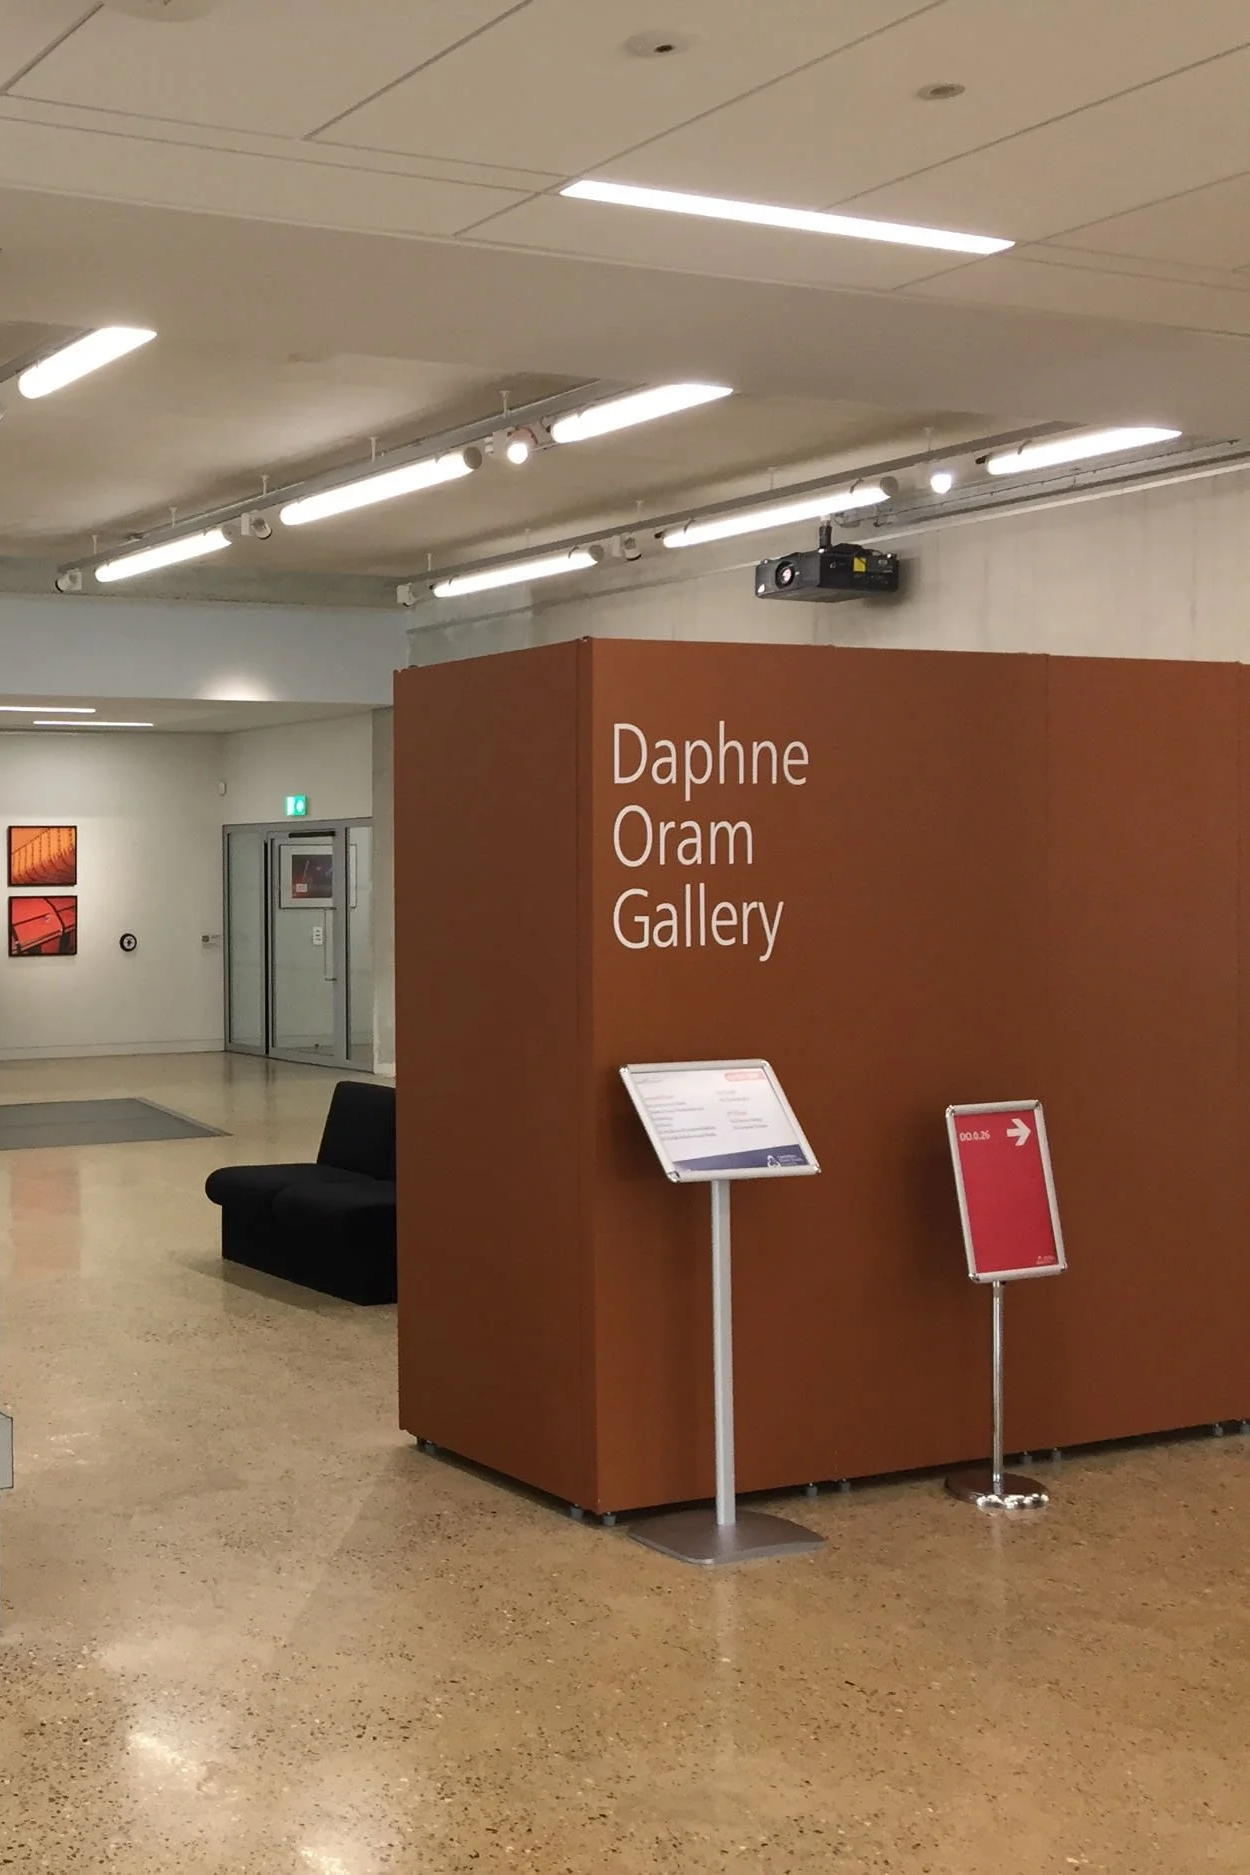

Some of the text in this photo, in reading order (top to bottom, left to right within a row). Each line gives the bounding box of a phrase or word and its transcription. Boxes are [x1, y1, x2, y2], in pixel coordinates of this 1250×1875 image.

[613, 720, 809, 802] Daphne
[613, 804, 753, 868] Oram
[612, 882, 785, 962] Gallery
